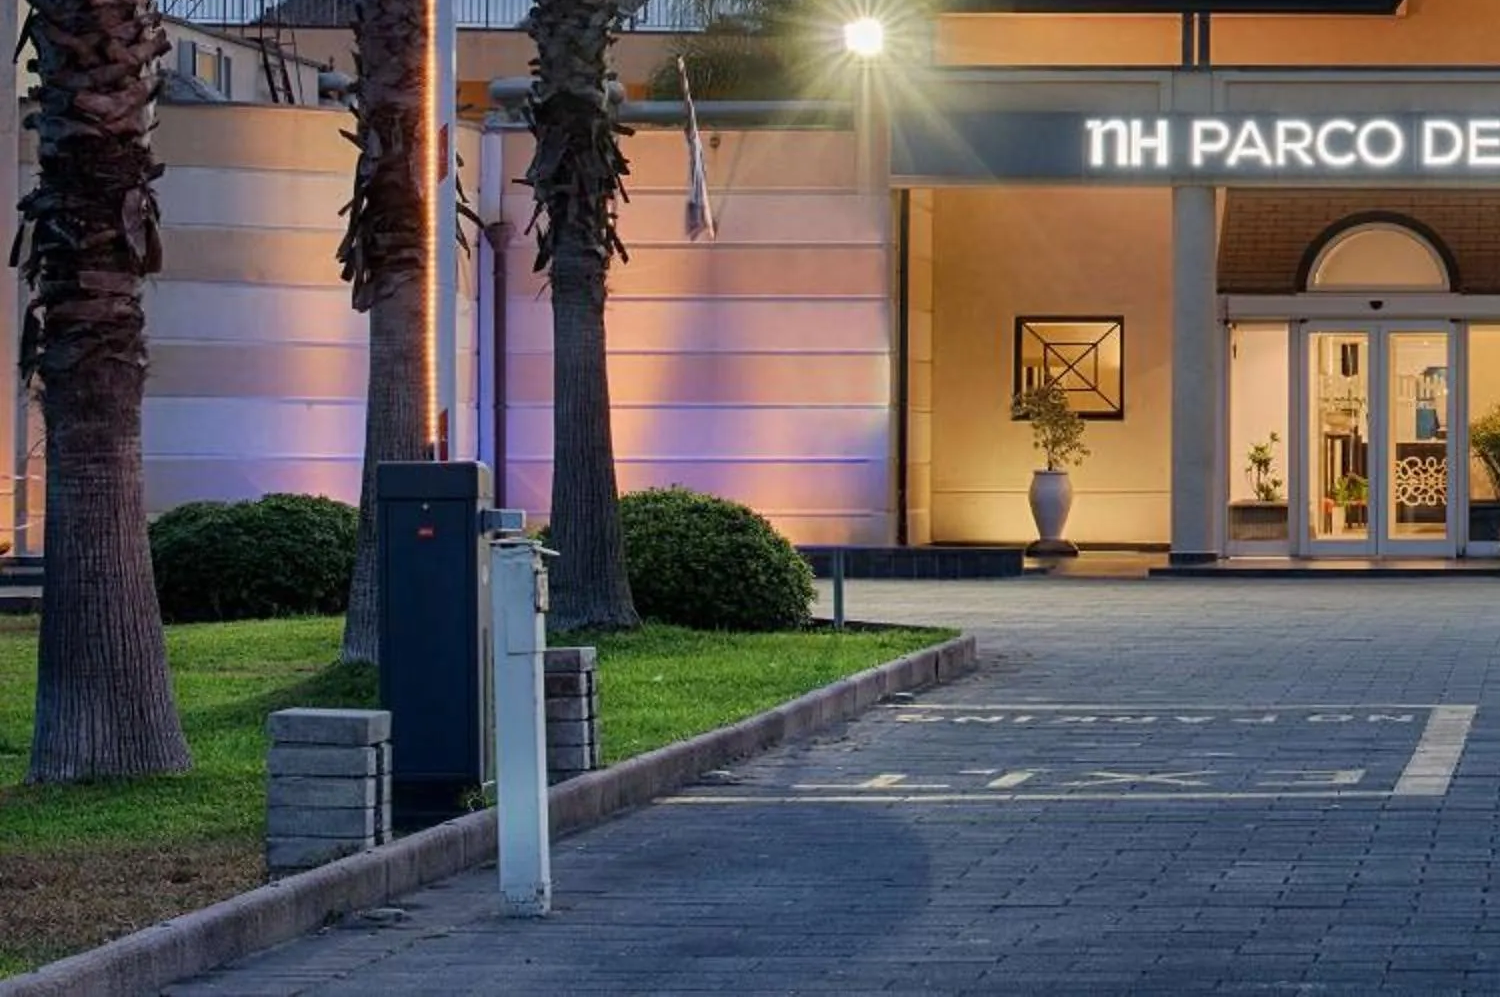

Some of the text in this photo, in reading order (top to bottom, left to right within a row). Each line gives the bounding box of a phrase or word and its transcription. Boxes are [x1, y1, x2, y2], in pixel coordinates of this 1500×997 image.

[1192, 119, 1404, 166] PARCO
[1306, 713, 1415, 723] NO
[792, 768, 1367, 789] EXIT
